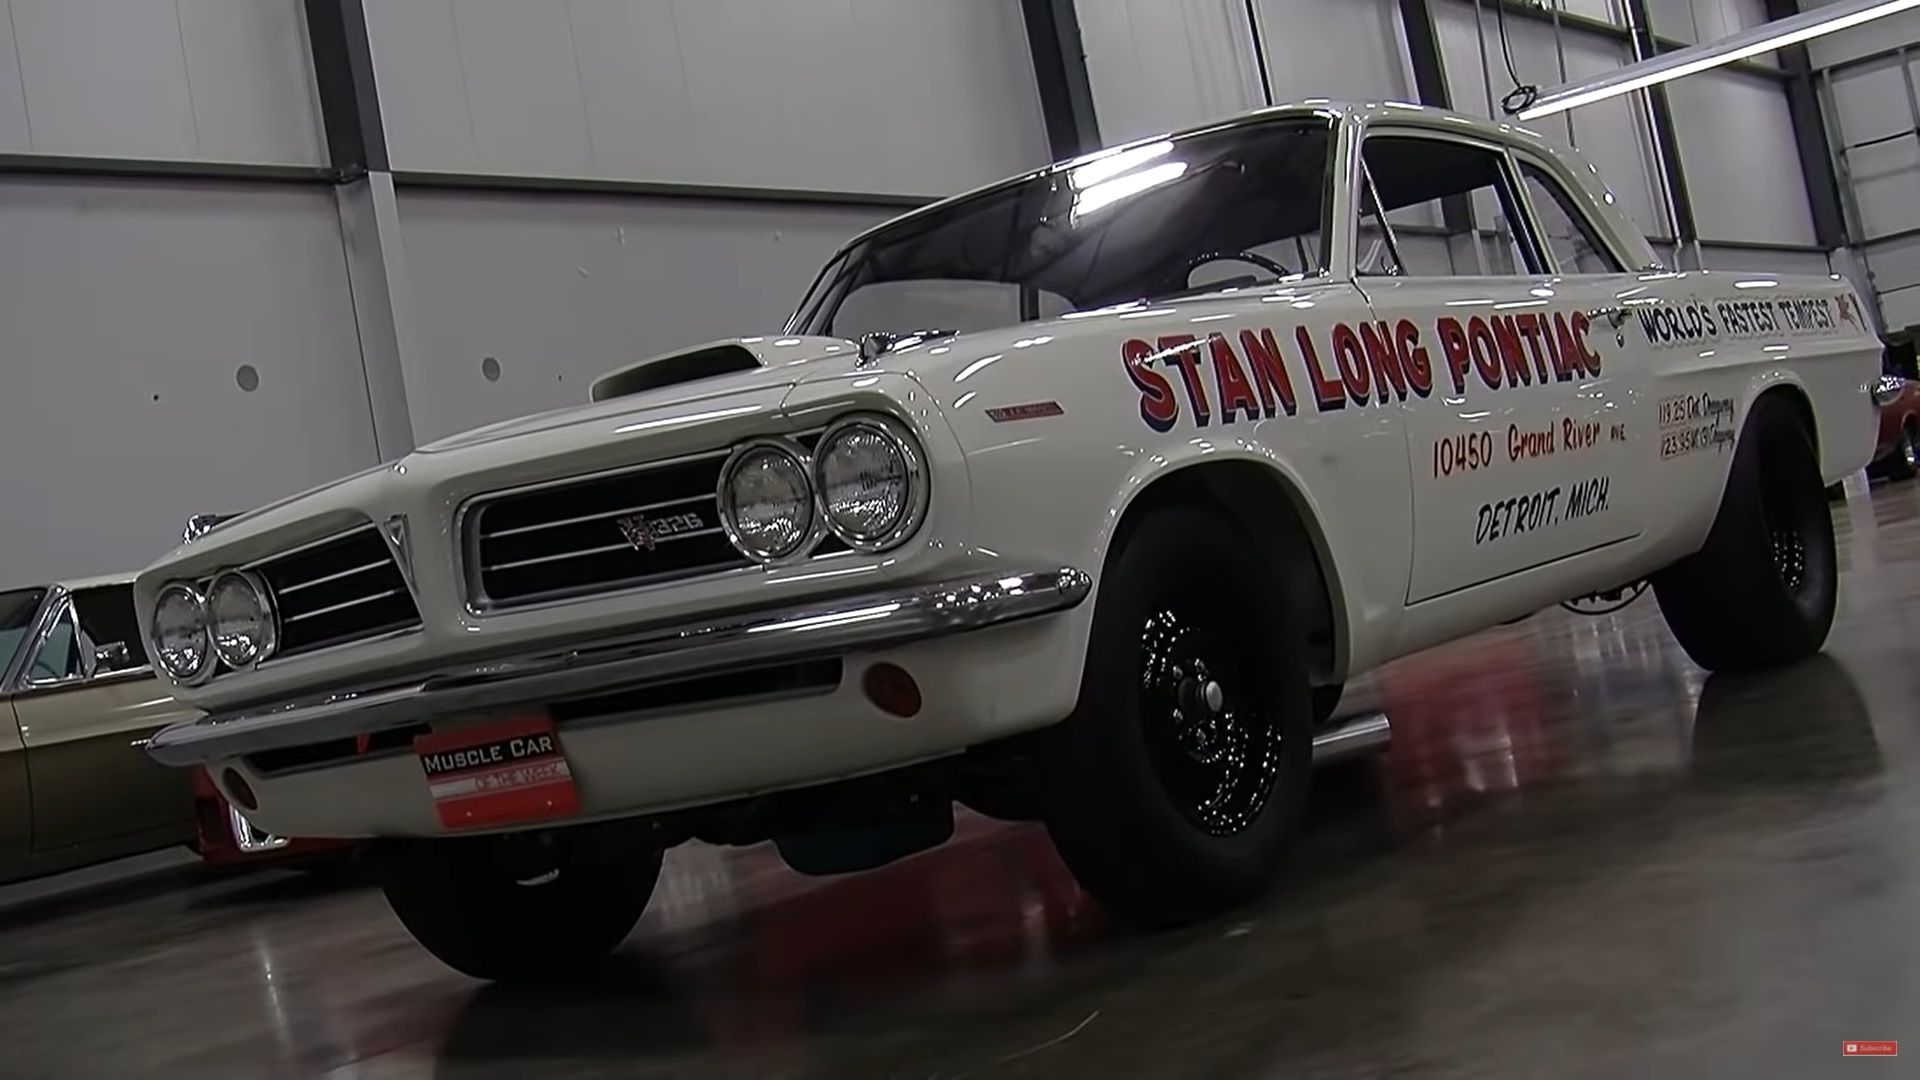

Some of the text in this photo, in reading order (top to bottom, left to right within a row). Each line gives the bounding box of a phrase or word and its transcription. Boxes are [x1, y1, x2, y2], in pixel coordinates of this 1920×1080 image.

[1637, 301, 1717, 343] WORLD'S
[1717, 301, 1781, 334] FASTEST
[1122, 311, 1601, 433] STAN LONG PONTIAC
[1432, 431, 1494, 479] 10450
[1507, 422, 1556, 461] Grand
[1562, 416, 1601, 451] River
[1565, 476, 1610, 521] MICH.
